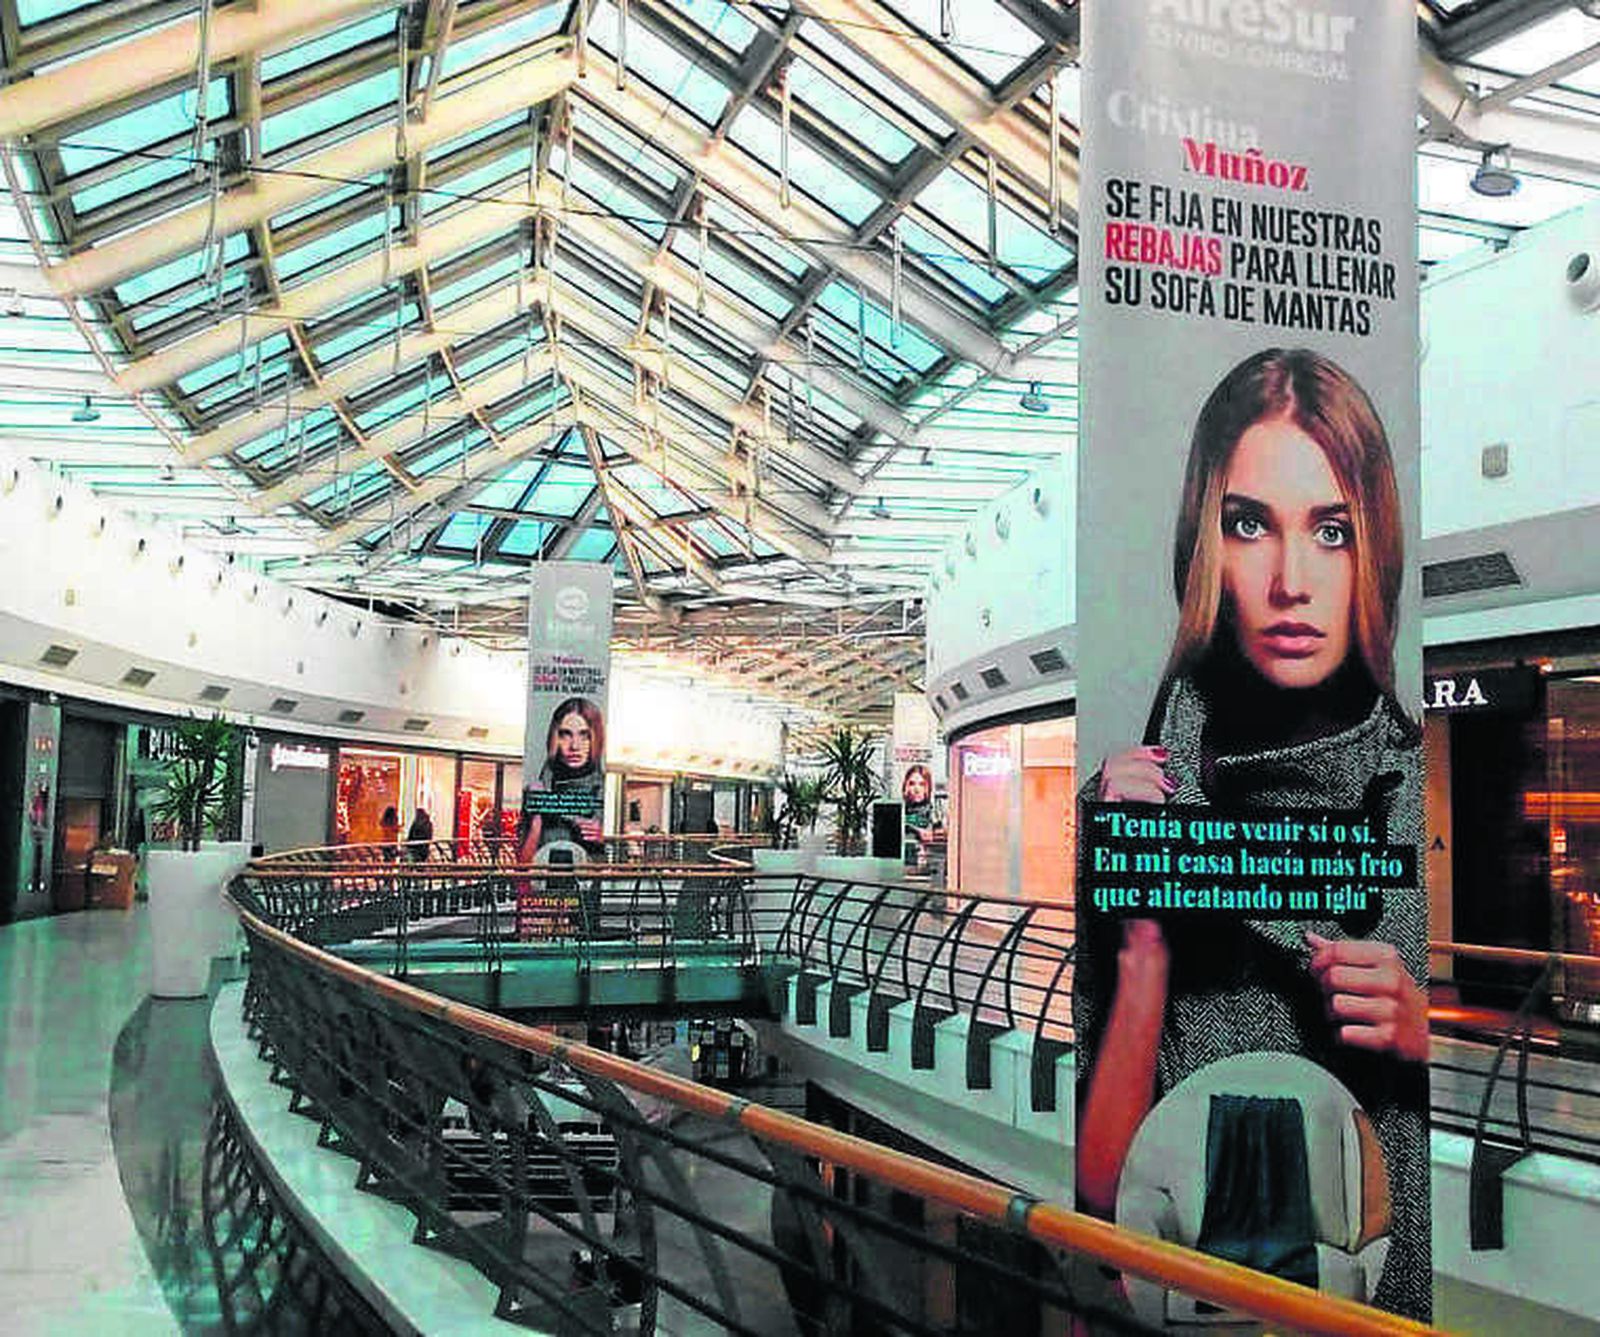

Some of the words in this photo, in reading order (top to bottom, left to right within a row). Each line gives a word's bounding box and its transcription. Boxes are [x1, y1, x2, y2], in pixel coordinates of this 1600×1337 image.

[1107, 90, 1260, 148] Cristina
[1182, 138, 1309, 191] Muñoz
[1105, 179, 1141, 219] SE
[1150, 185, 1203, 230] FIJA
[1212, 197, 1243, 238] EN
[1251, 203, 1382, 255] NUESTRAS
[1105, 222, 1222, 276] REBAJAS
[1231, 242, 1298, 287] PARA
[1306, 253, 1396, 300] LLENAR
[1105, 266, 1141, 306] SU
[1150, 270, 1216, 317] SOFÁ
[1224, 283, 1256, 323] DE
[1263, 290, 1371, 336] MANTAS
[1423, 678, 1488, 708] RA
[1188, 822, 1237, 845] que
[1241, 816, 1304, 842] venir
[1333, 824, 1347, 843] o
[1093, 847, 1128, 872] En
[1135, 847, 1170, 874] mi
[1178, 852, 1234, 875] casa
[1240, 848, 1305, 877] hacía
[1311, 849, 1355, 877] más
[1360, 850, 1403, 878] frío
[1093, 886, 1141, 911] que
[1147, 881, 1282, 911] alicatando
[1289, 887, 1319, 910] un
